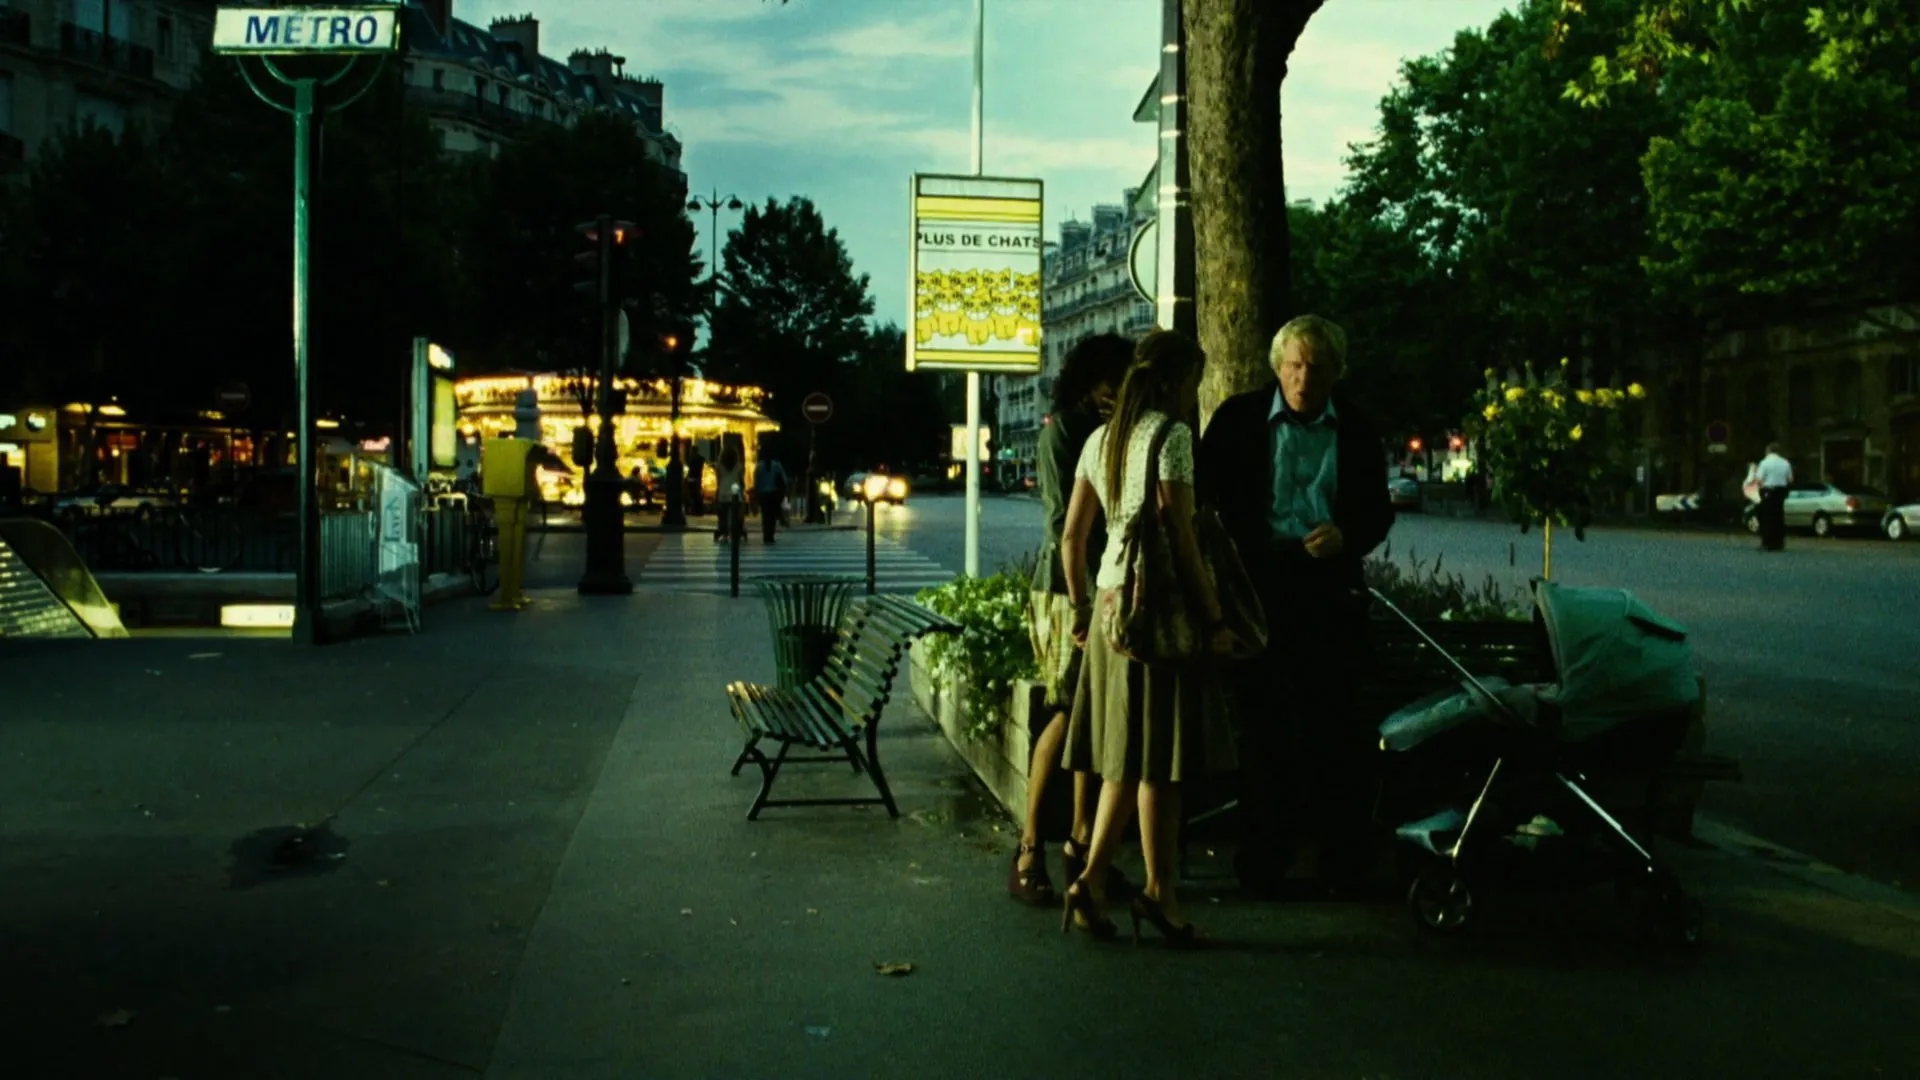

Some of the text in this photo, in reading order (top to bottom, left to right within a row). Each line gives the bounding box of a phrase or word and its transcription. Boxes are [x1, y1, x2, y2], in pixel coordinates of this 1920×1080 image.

[245, 15, 378, 44] METRO
[961, 233, 982, 247] DE
[988, 234, 1041, 248] CHATS
